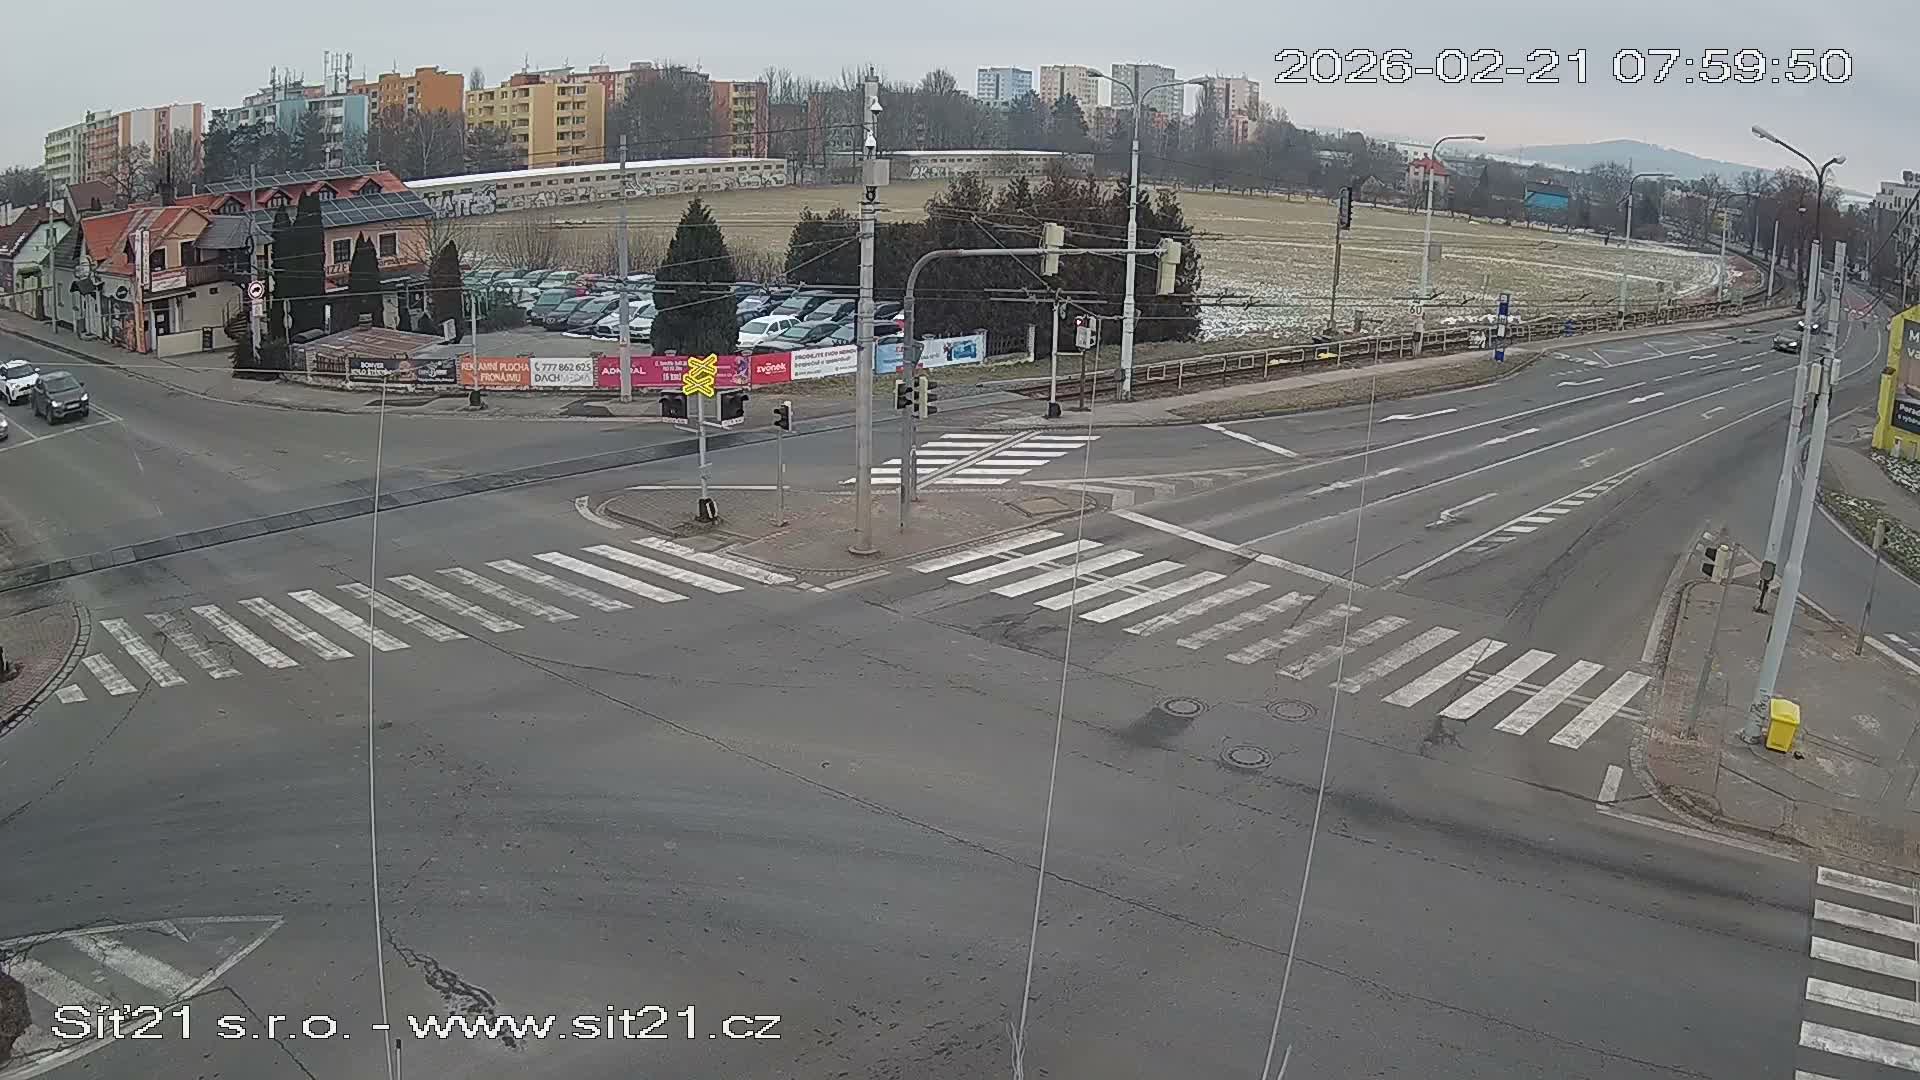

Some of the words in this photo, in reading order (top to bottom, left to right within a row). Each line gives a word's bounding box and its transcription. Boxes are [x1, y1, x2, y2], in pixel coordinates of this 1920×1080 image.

[1409, 305, 1422, 315] 60
[461, 361, 499, 371] REKAMNÍ
[500, 363, 529, 372] PLOCHA
[542, 363, 557, 371] 777
[558, 363, 574, 372] 862
[575, 363, 591, 372] 625
[601, 366, 647, 375] ADMRAL
